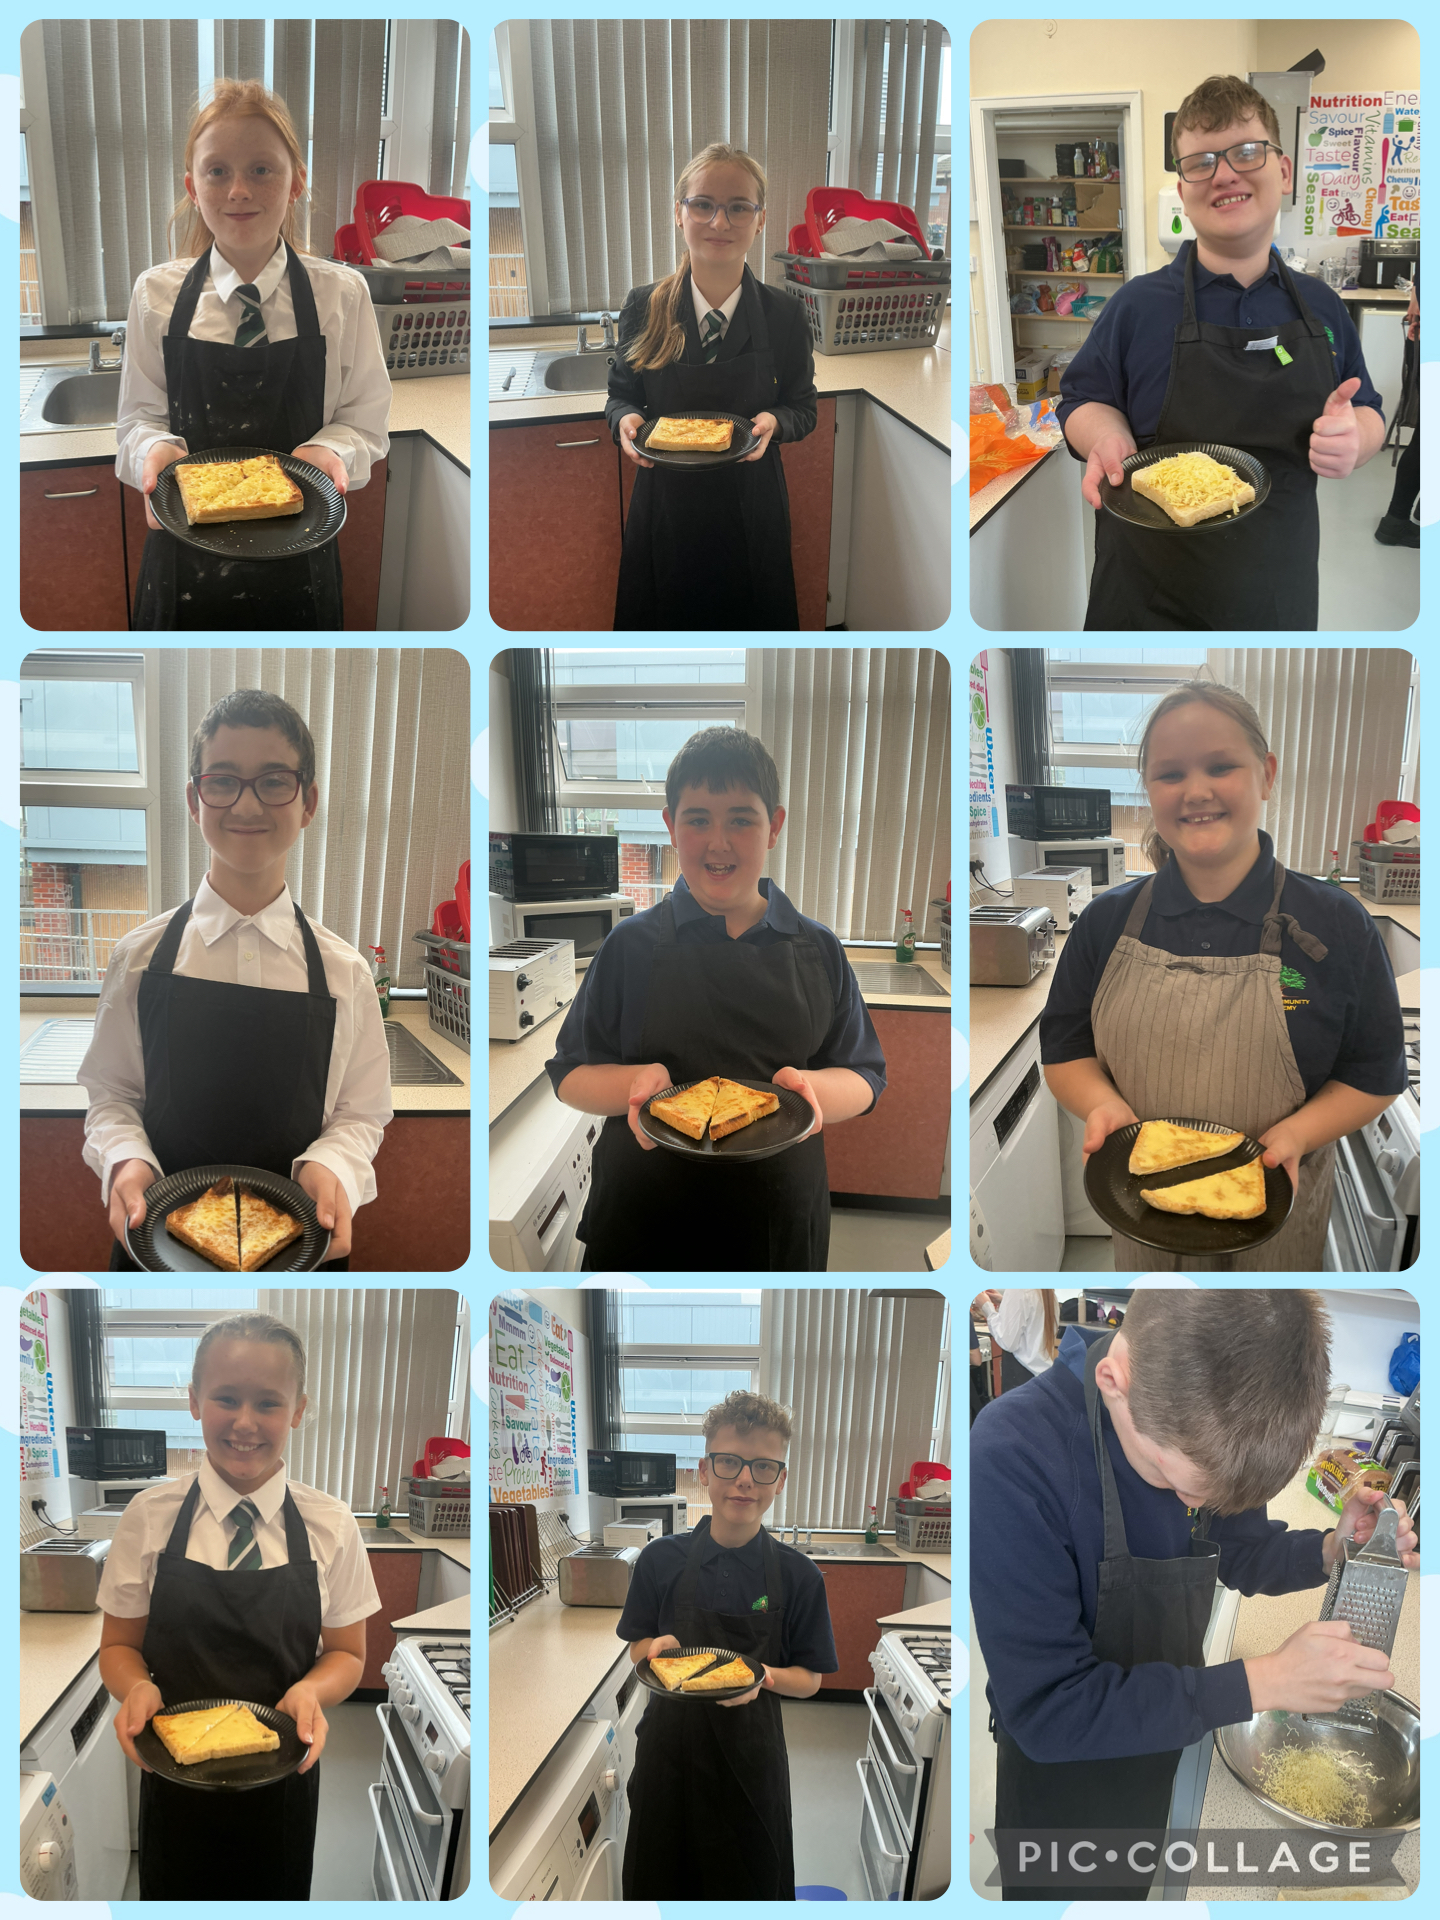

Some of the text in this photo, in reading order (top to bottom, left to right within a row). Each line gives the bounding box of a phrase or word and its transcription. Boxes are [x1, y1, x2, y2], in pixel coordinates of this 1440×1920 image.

[1310, 95, 1382, 108] Nutrition
[1384, 91, 1420, 105] Ene
[1309, 111, 1365, 124] Savour
[1328, 127, 1354, 138] Spice
[1306, 148, 1351, 162] Taste
[1352, 127, 1363, 172] Flavour
[1361, 110, 1381, 184] Vitamins
[1404, 152, 1420, 163] Re
[1321, 172, 1360, 191] Dairy
[1386, 175, 1413, 185] Chewy
[1321, 188, 1339, 197] Eat
[1341, 190, 1362, 199] Enjoy
[1304, 172, 1320, 235] Season
[1361, 187, 1377, 227] Chewy
[1390, 213, 1408, 222] Eat
[985, 727, 995, 794] Water
[970, 805, 987, 819] Spice
[498, 1314, 526, 1341] Mmmm
[551, 1315, 564, 1341] Eat
[495, 1328, 525, 1374] Eat
[544, 1335, 570, 1359] Vegetables
[489, 1366, 528, 1394] Nutrition
[545, 1379, 561, 1397] Family
[46, 1372, 55, 1436] Water
[526, 1344, 540, 1461] Hydrate
[29, 1421, 48, 1434] Healthy
[489, 1387, 501, 1459] Cooking
[505, 1415, 531, 1431] Savour
[32, 1447, 48, 1460] Spice
[557, 1443, 571, 1456] Healthy
[548, 1454, 574, 1467] Ingredients
[503, 1457, 540, 1486] Protein
[558, 1467, 571, 1479] Spice
[493, 1484, 549, 1504] Vegetables
